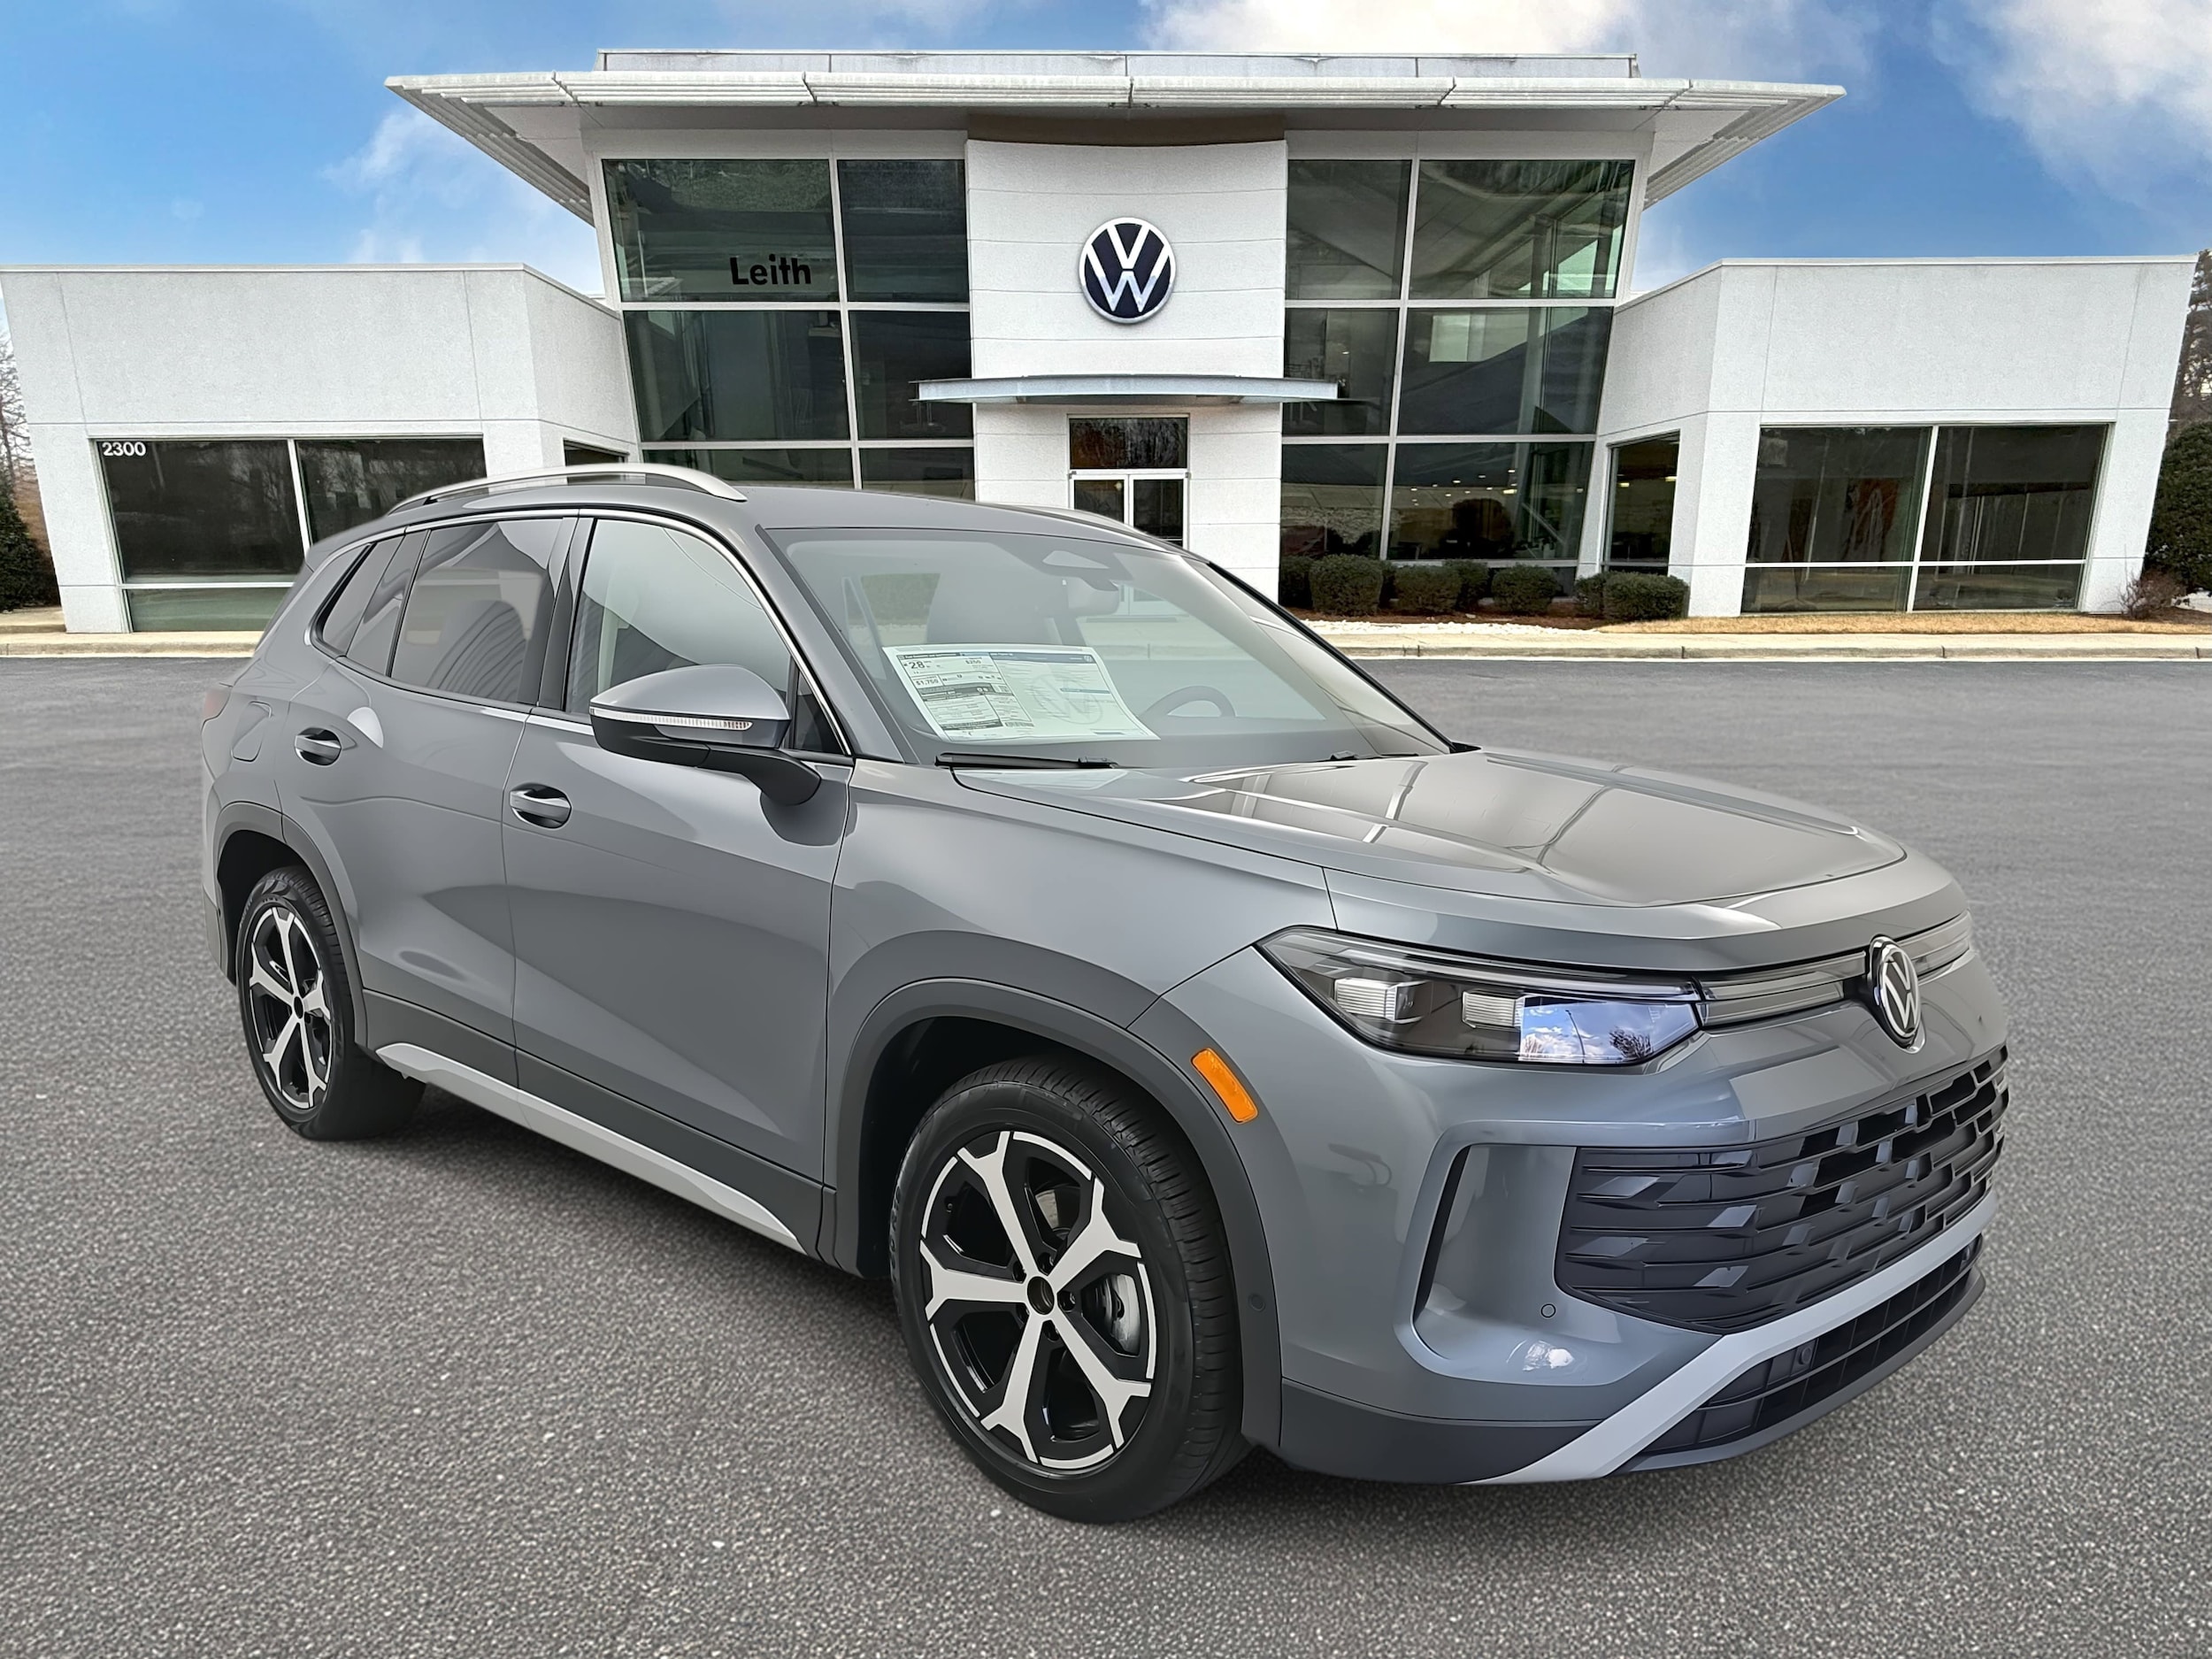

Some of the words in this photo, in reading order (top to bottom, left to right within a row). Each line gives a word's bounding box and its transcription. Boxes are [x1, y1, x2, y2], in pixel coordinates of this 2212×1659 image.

[730, 254, 811, 285] Leith
[1082, 220, 1172, 315] VW
[102, 442, 146, 456] 2300
[909, 661, 926, 670] 28
